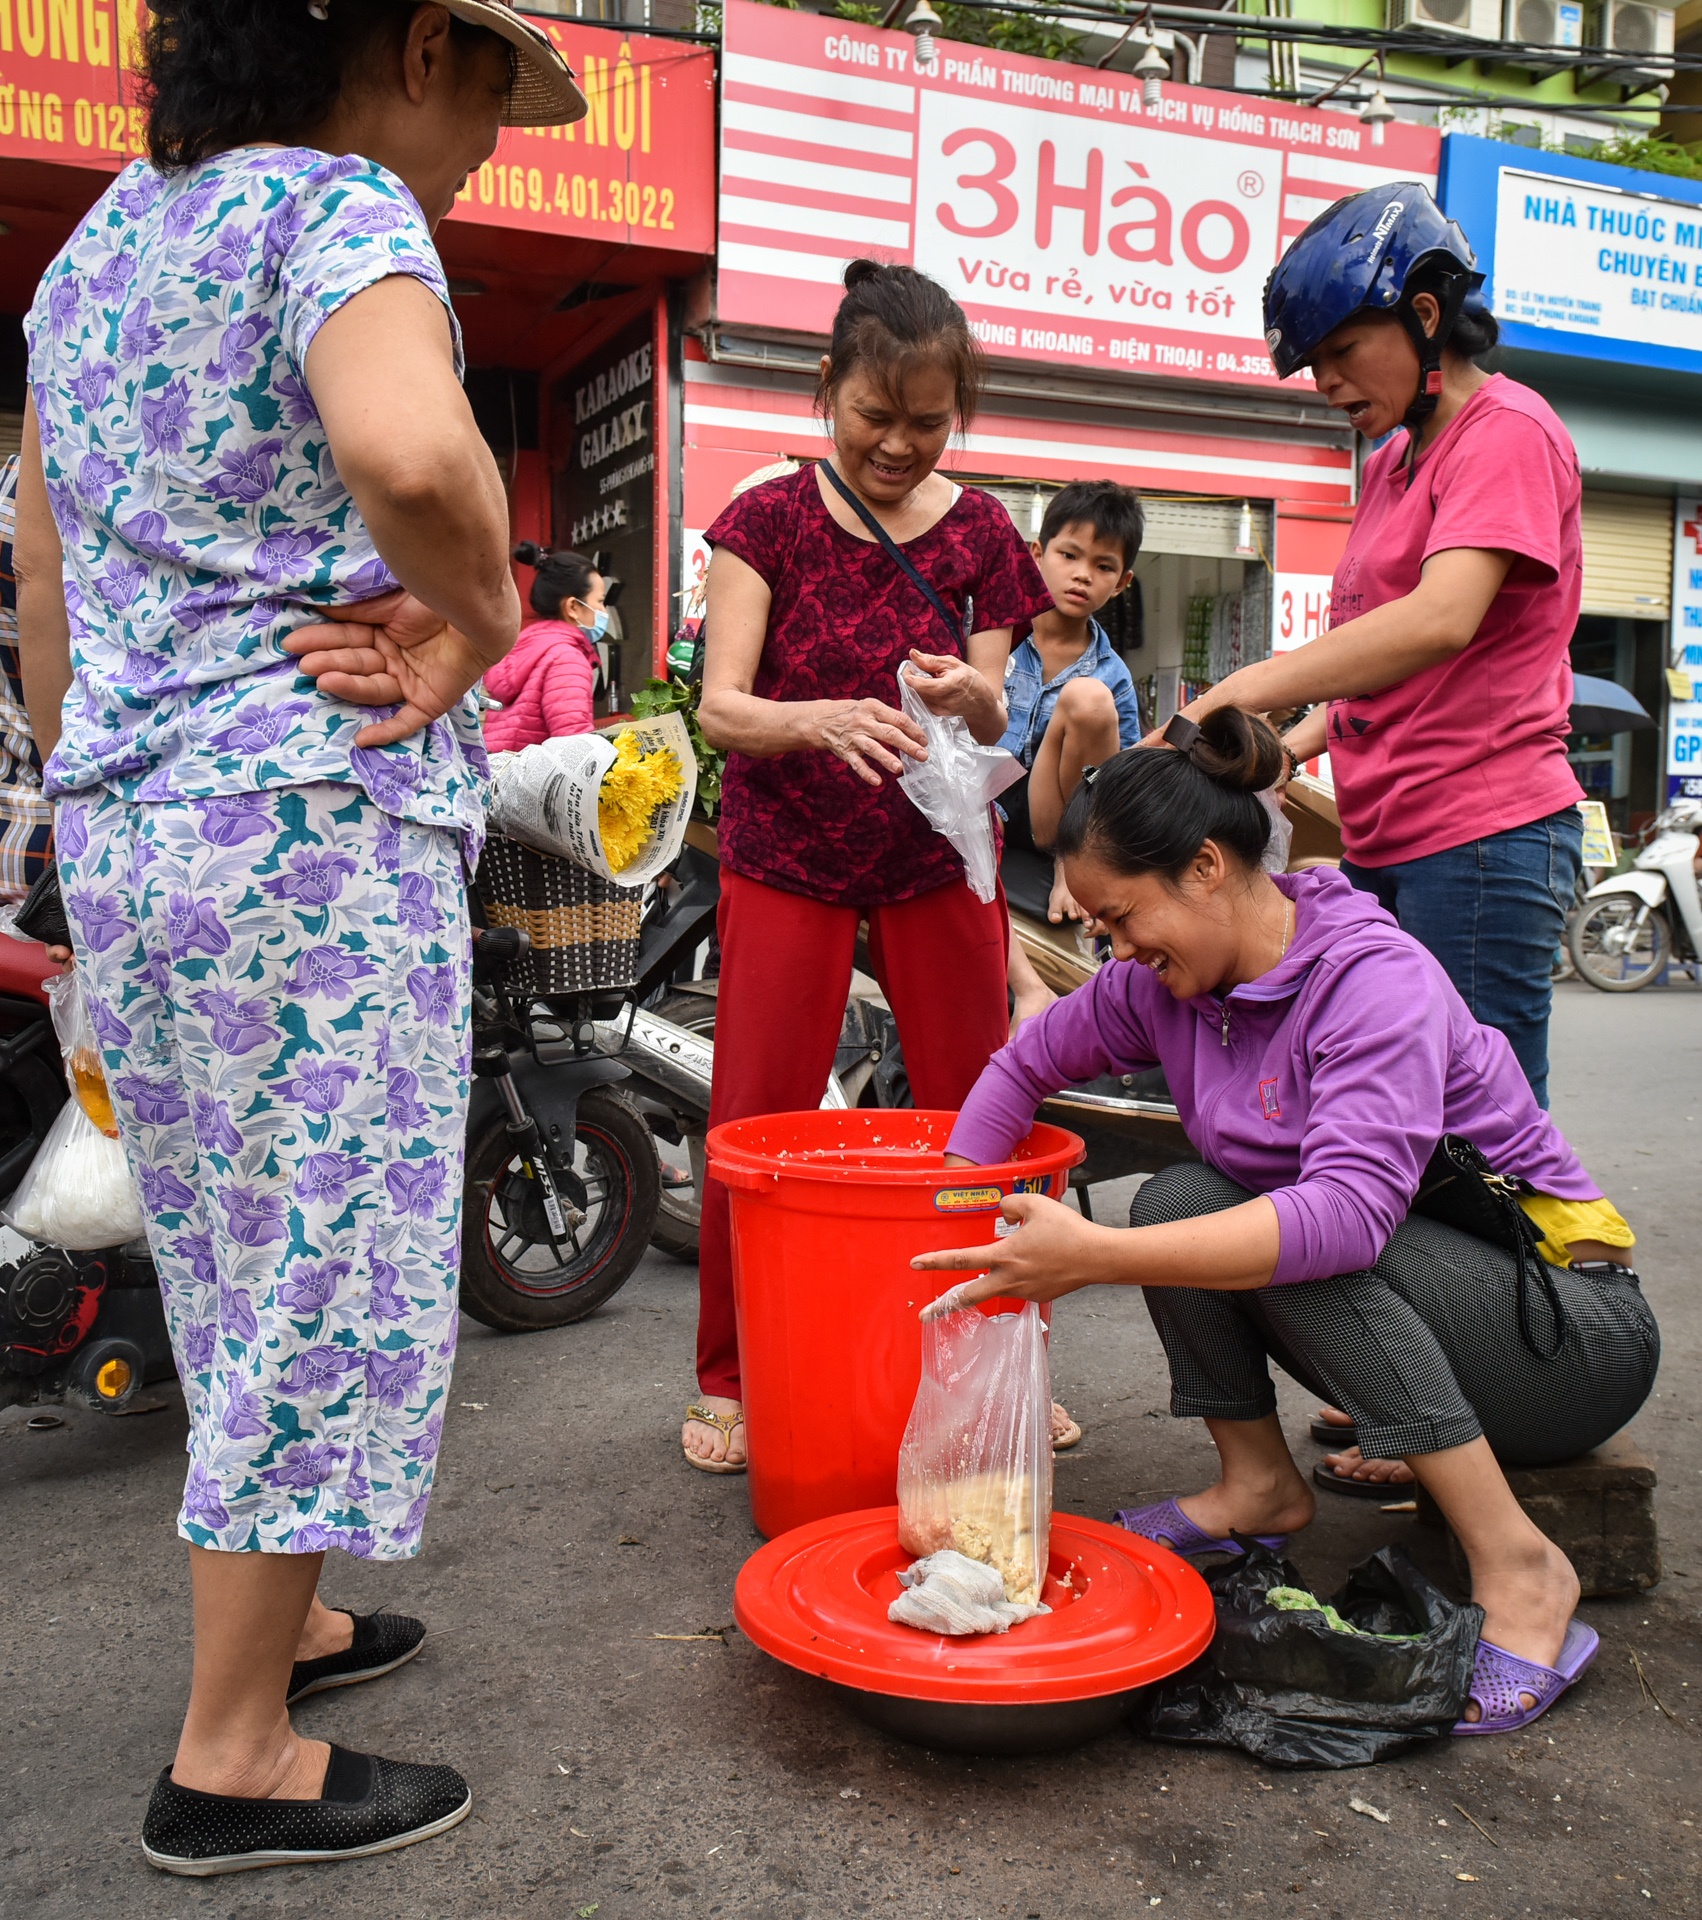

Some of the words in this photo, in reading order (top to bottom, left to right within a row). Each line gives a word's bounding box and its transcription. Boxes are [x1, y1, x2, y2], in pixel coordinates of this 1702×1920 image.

[824, 35, 880, 66] CÔNG
[885, 47, 908, 72] TY
[1002, 69, 1074, 103] THƯƠNG
[1079, 84, 1115, 112] MẠI
[1119, 88, 1142, 115] VÀ
[1192, 103, 1215, 131] VỤ
[1269, 116, 1322, 145] THẠCH
[1326, 125, 1361, 151] SƠN
[478, 161, 675, 231] 0169.401.3022
[1524, 195, 1577, 228] NHÀ
[1587, 207, 1667, 243] THUỐC
[1598, 247, 1688, 285] CHUYÊN
[1046, 268, 1094, 305] rẻ,
[1109, 280, 1173, 310] vừa
[1186, 286, 1236, 318] tốt
[1021, 328, 1094, 356] KHOANG
[1109, 337, 1146, 364] ĐIỆN
[1155, 344, 1203, 372] THOẠI
[575, 342, 652, 425] KARAOKE
[579, 401, 647, 470] GALAXY
[1280, 590, 1293, 639] 3
